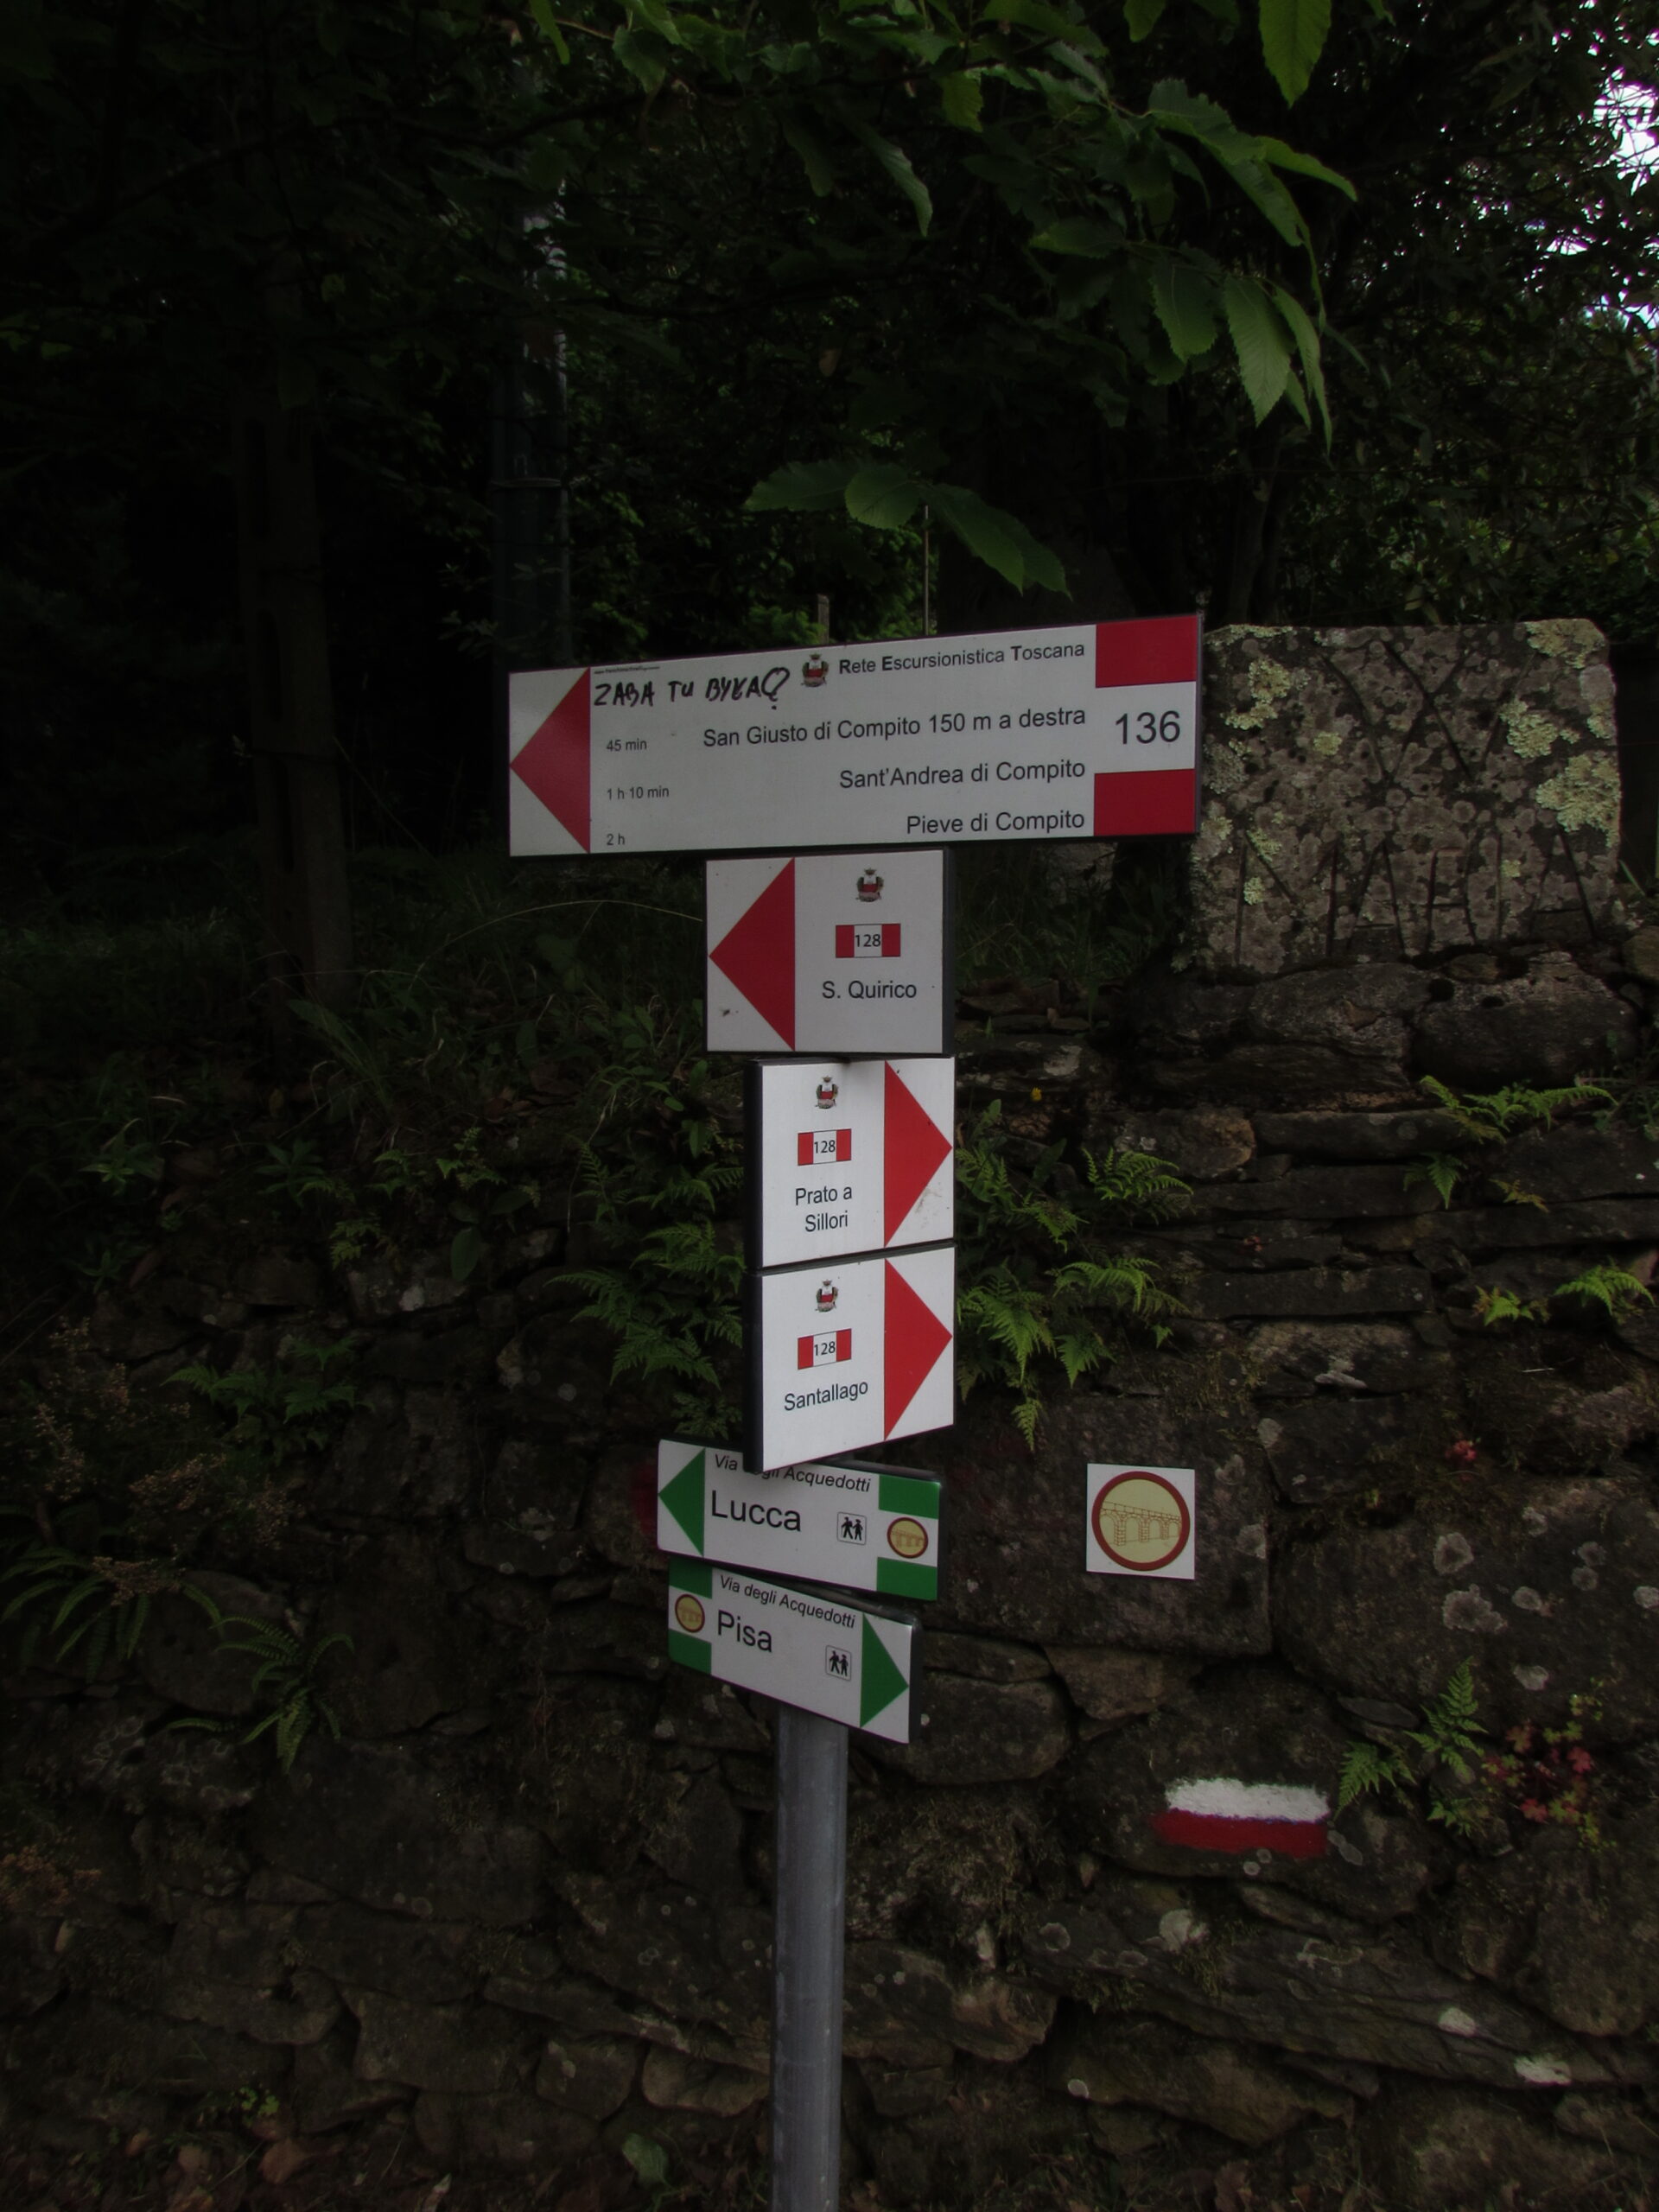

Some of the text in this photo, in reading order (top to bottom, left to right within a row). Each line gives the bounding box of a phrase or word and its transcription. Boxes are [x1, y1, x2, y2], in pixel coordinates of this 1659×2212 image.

[839, 644, 1084, 675] Rete Escursionistica Toscana
[667, 680, 695, 702] TU
[702, 707, 1085, 747] San Giusto di Compito 150 m a destra
[1115, 709, 1181, 745] 136
[606, 737, 647, 752] 45 min
[839, 759, 1086, 789] Sant'Andrea di Compito
[607, 785, 670, 801] 1 h 10 min
[906, 810, 1085, 835] Pieve di Compito
[606, 833, 626, 847] 2 h
[854, 933, 881, 948] 128
[822, 980, 918, 1000] S. Quirico
[813, 1139, 836, 1154] 128
[795, 1185, 853, 1206] Prato a
[804, 1210, 849, 1233] Sillori
[813, 1340, 836, 1357] 128
[784, 1381, 868, 1412] Santallago
[715, 1453, 738, 1471] Via
[783, 1466, 871, 1491] Acquedotti
[711, 1489, 801, 1532] Lucca
[720, 1574, 856, 1628] Via degli Acquedotti
[717, 1609, 772, 1653] Pisa
